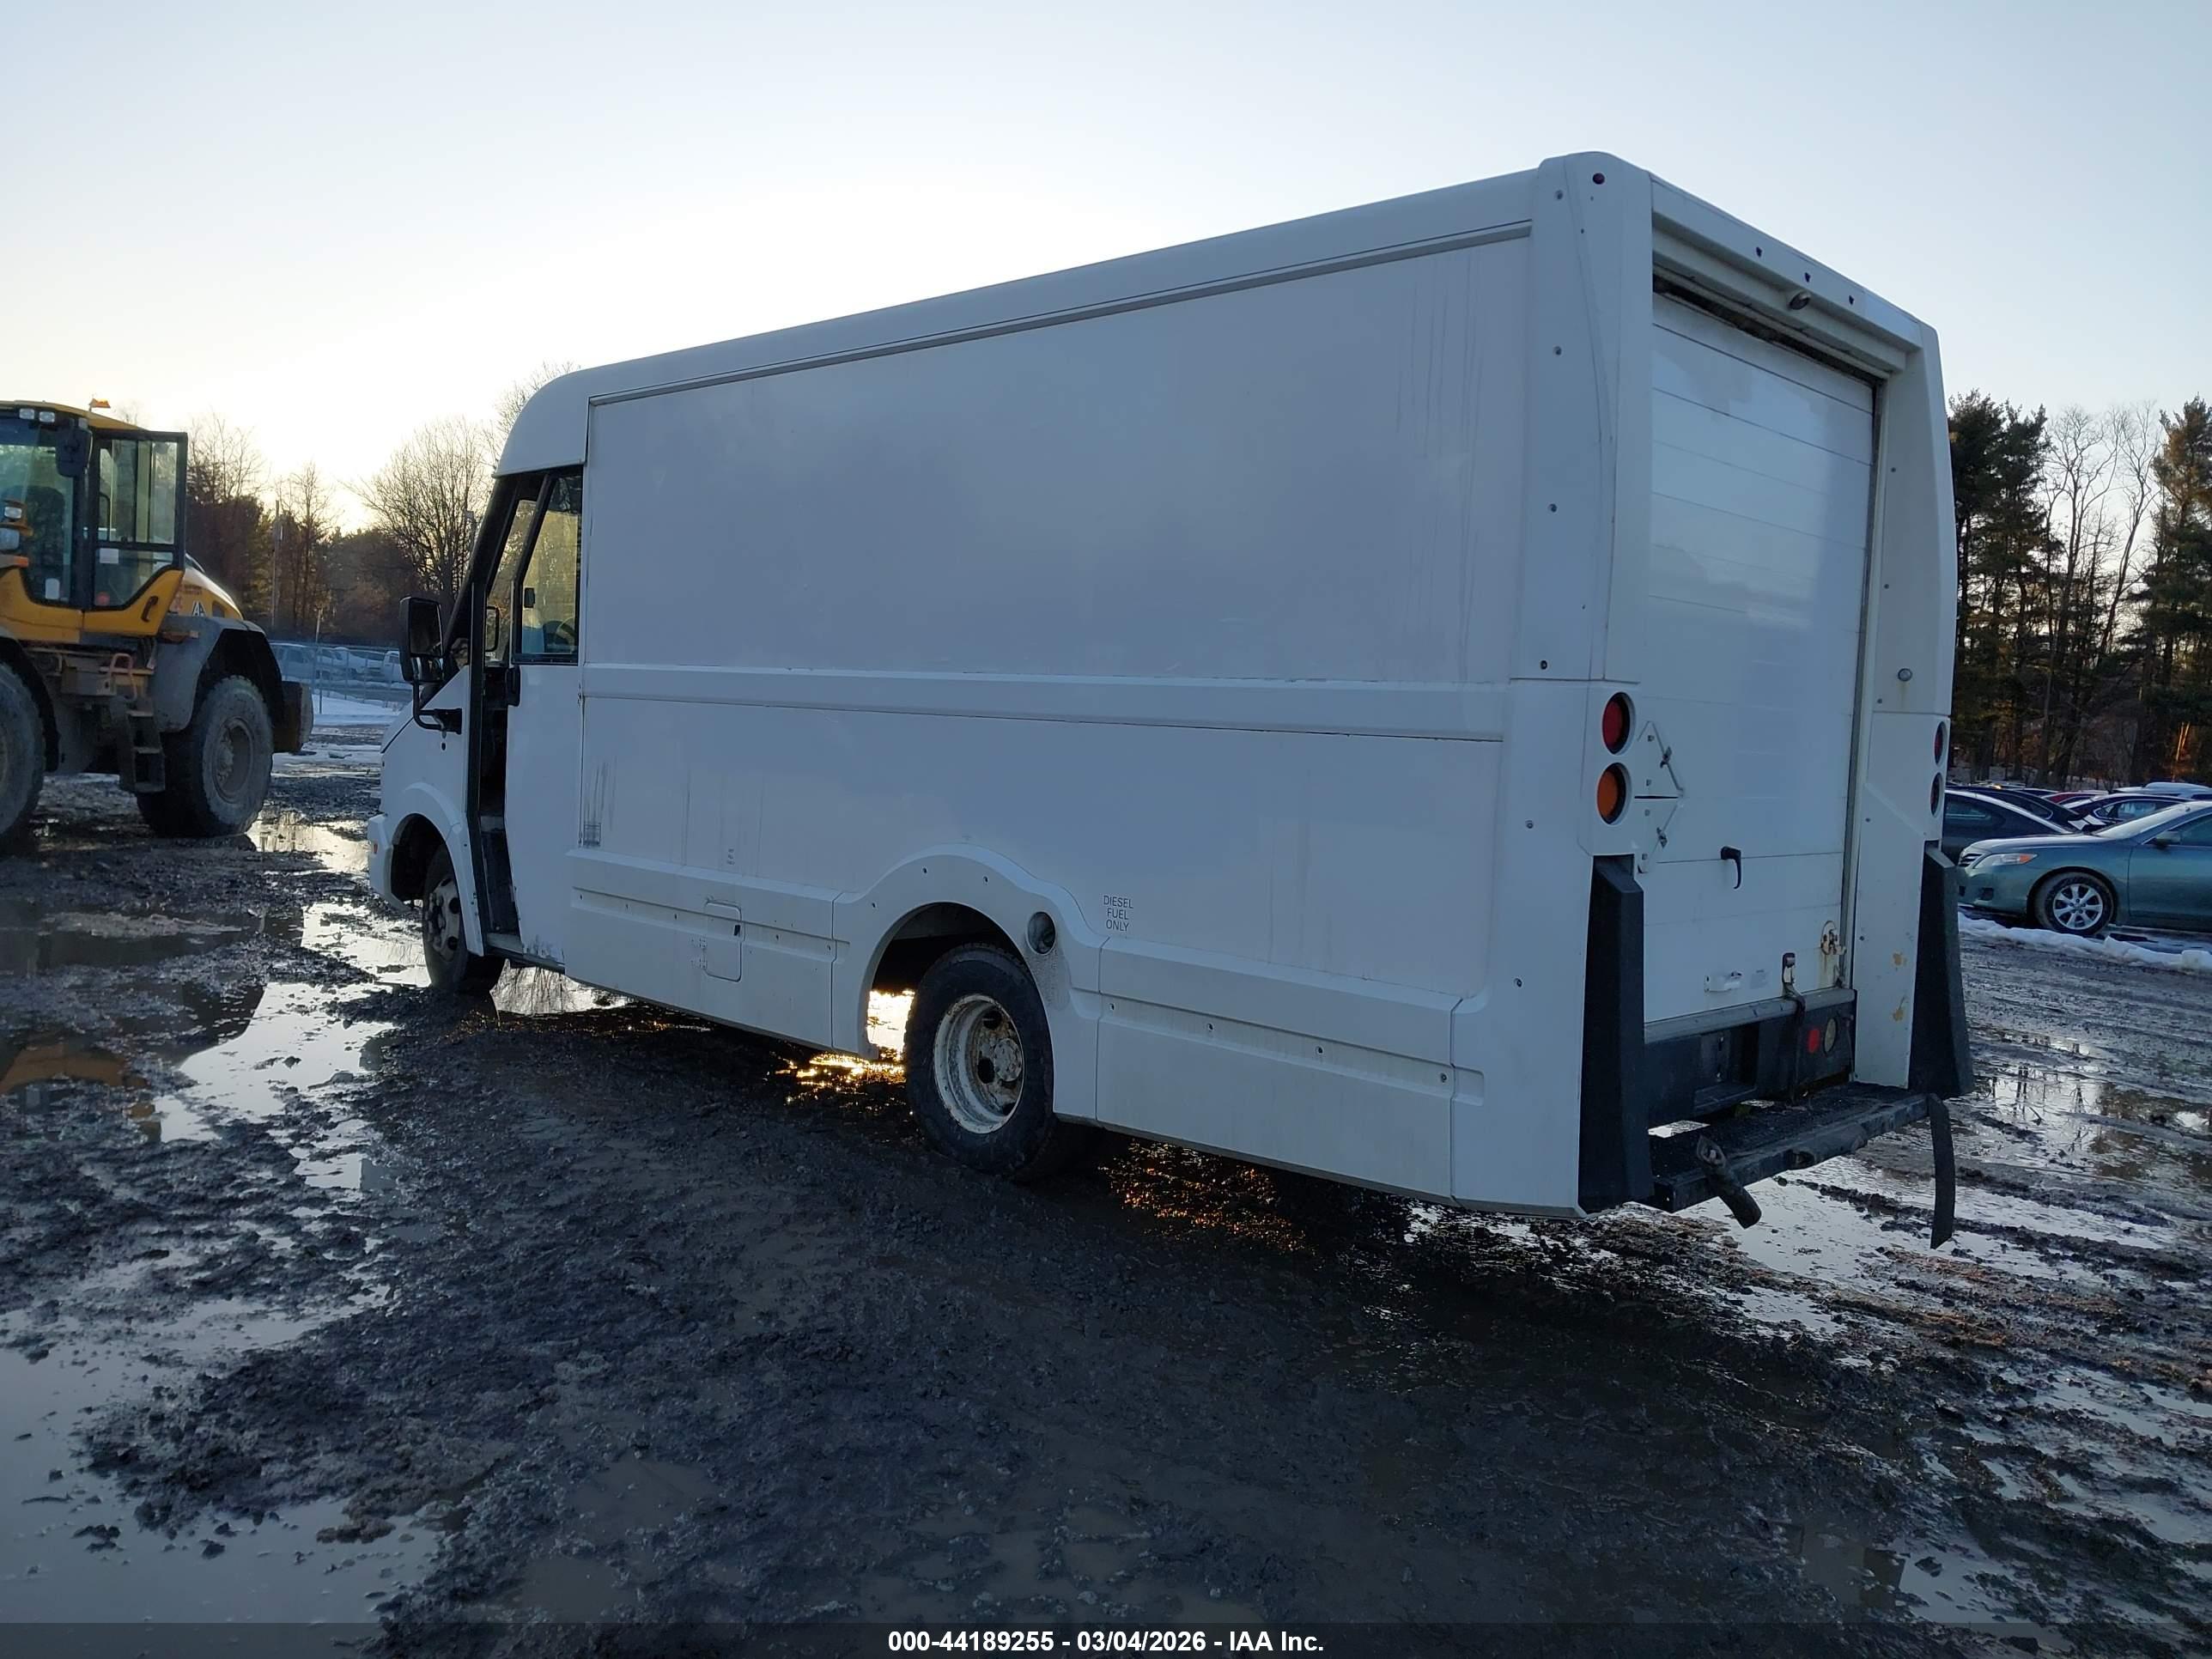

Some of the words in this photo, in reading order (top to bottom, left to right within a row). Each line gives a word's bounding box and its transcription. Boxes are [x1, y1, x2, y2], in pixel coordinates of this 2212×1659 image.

[1103, 895, 1133, 909] DIESEL
[1107, 908, 1128, 920] FUEL
[1106, 919, 1129, 932] ONLY
